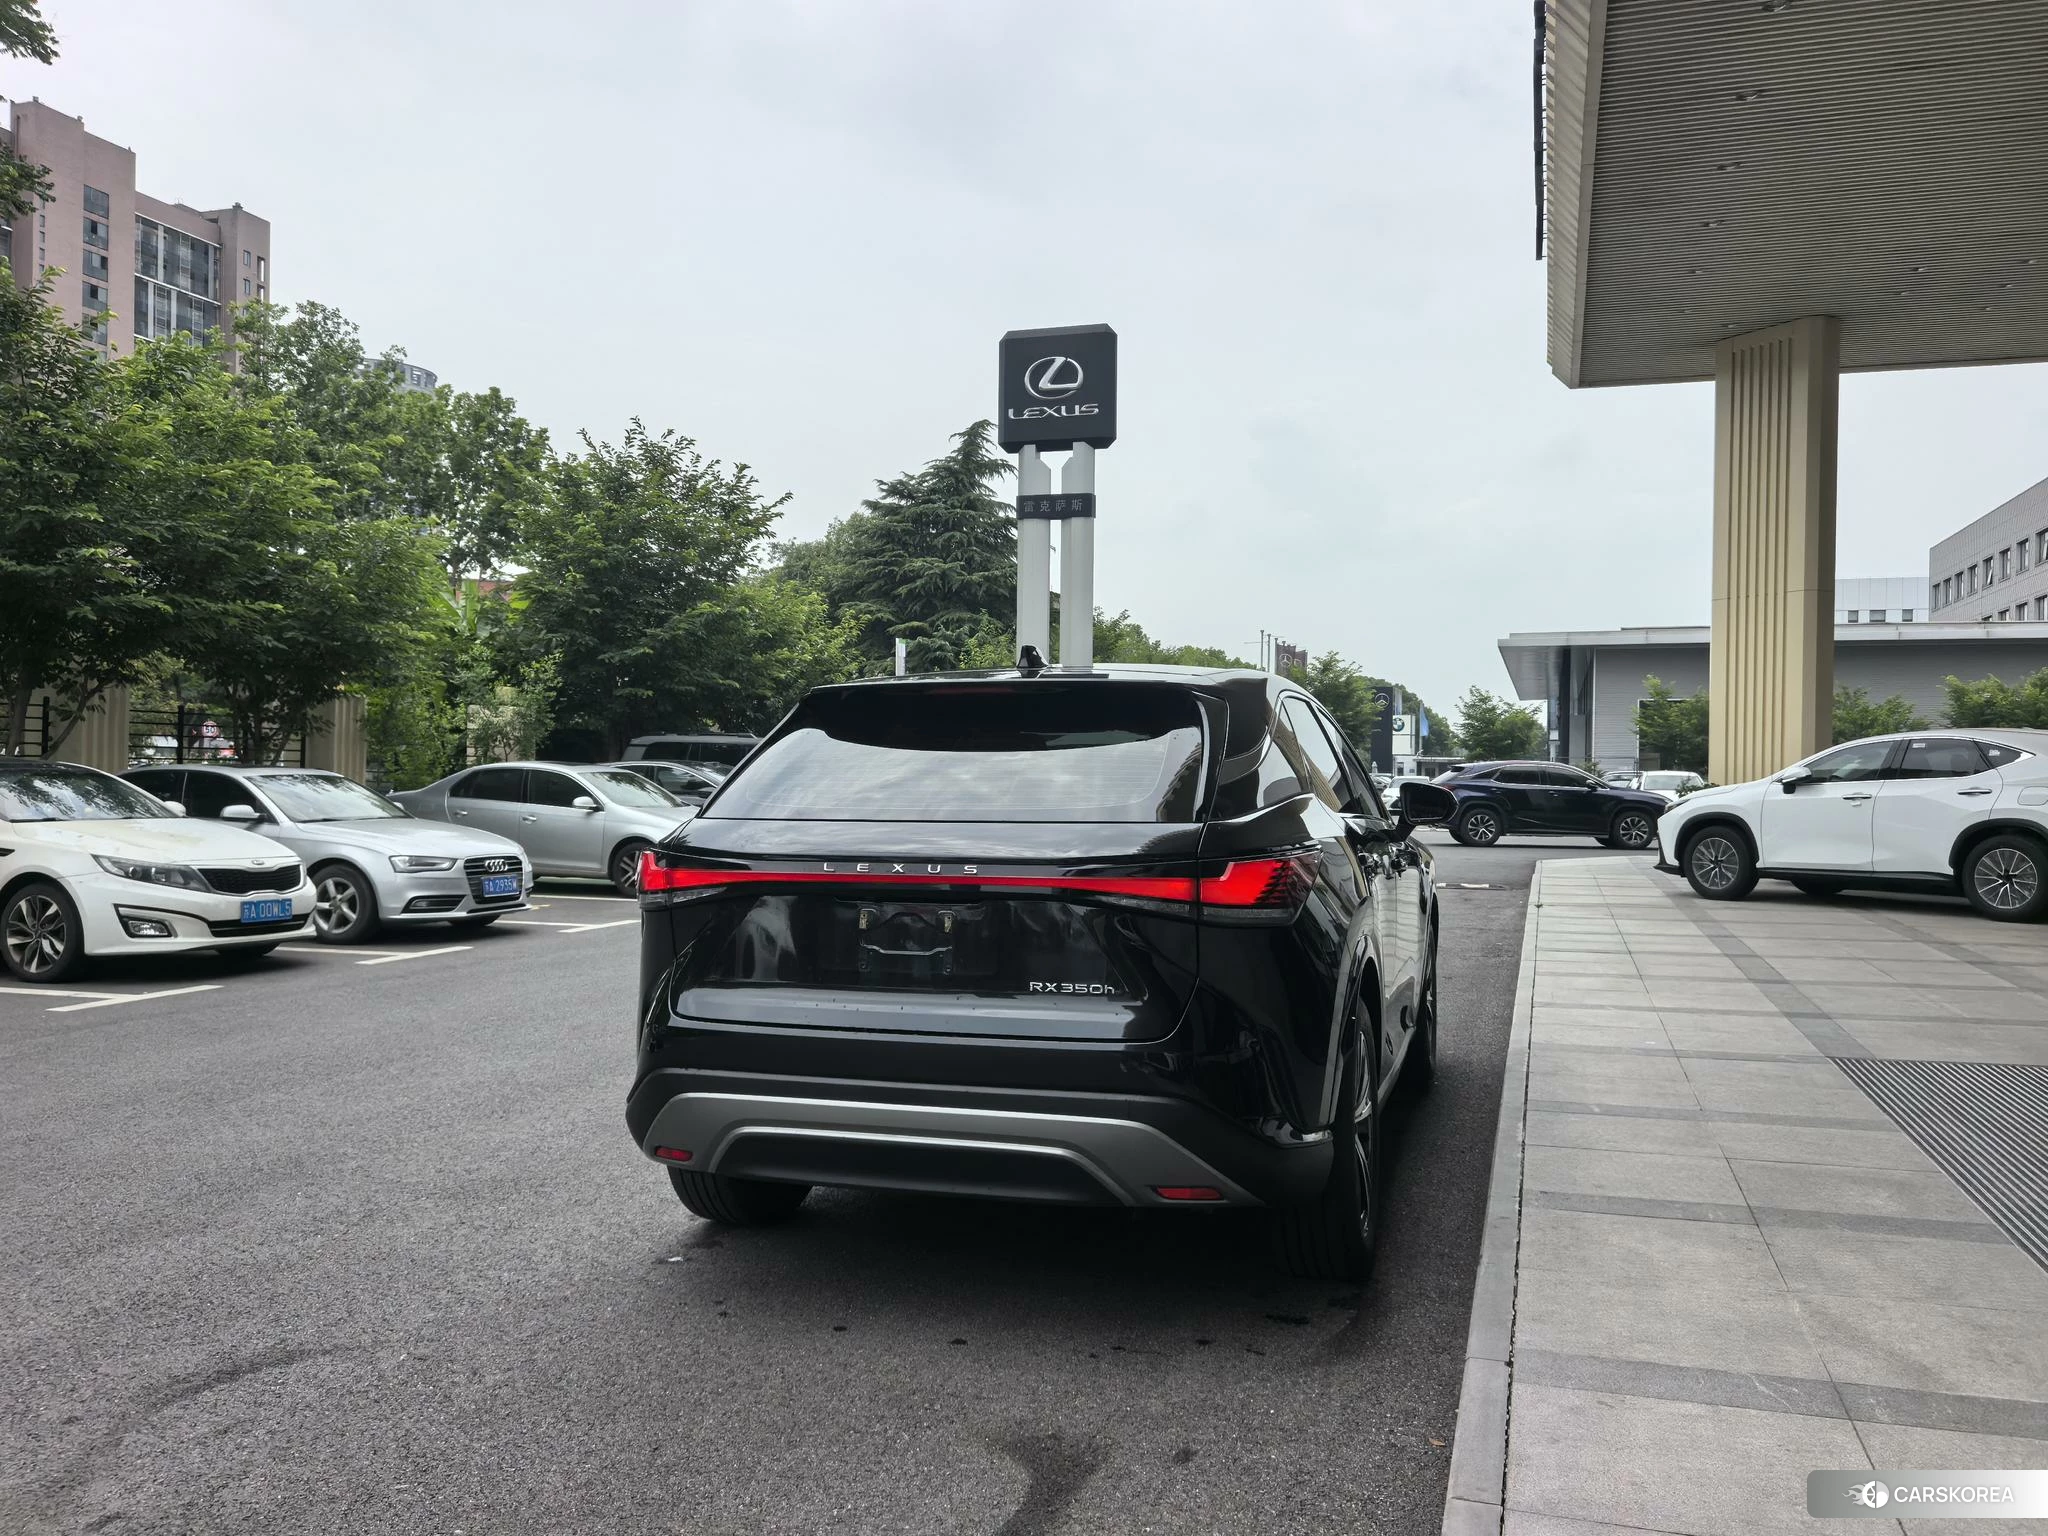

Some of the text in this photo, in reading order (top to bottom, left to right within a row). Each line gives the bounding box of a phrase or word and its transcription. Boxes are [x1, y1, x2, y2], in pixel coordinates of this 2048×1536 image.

[1008, 403, 1100, 420] LEXUS
[1023, 498, 1083, 512] 雷克萨斯
[823, 862, 978, 874] LEXUS
